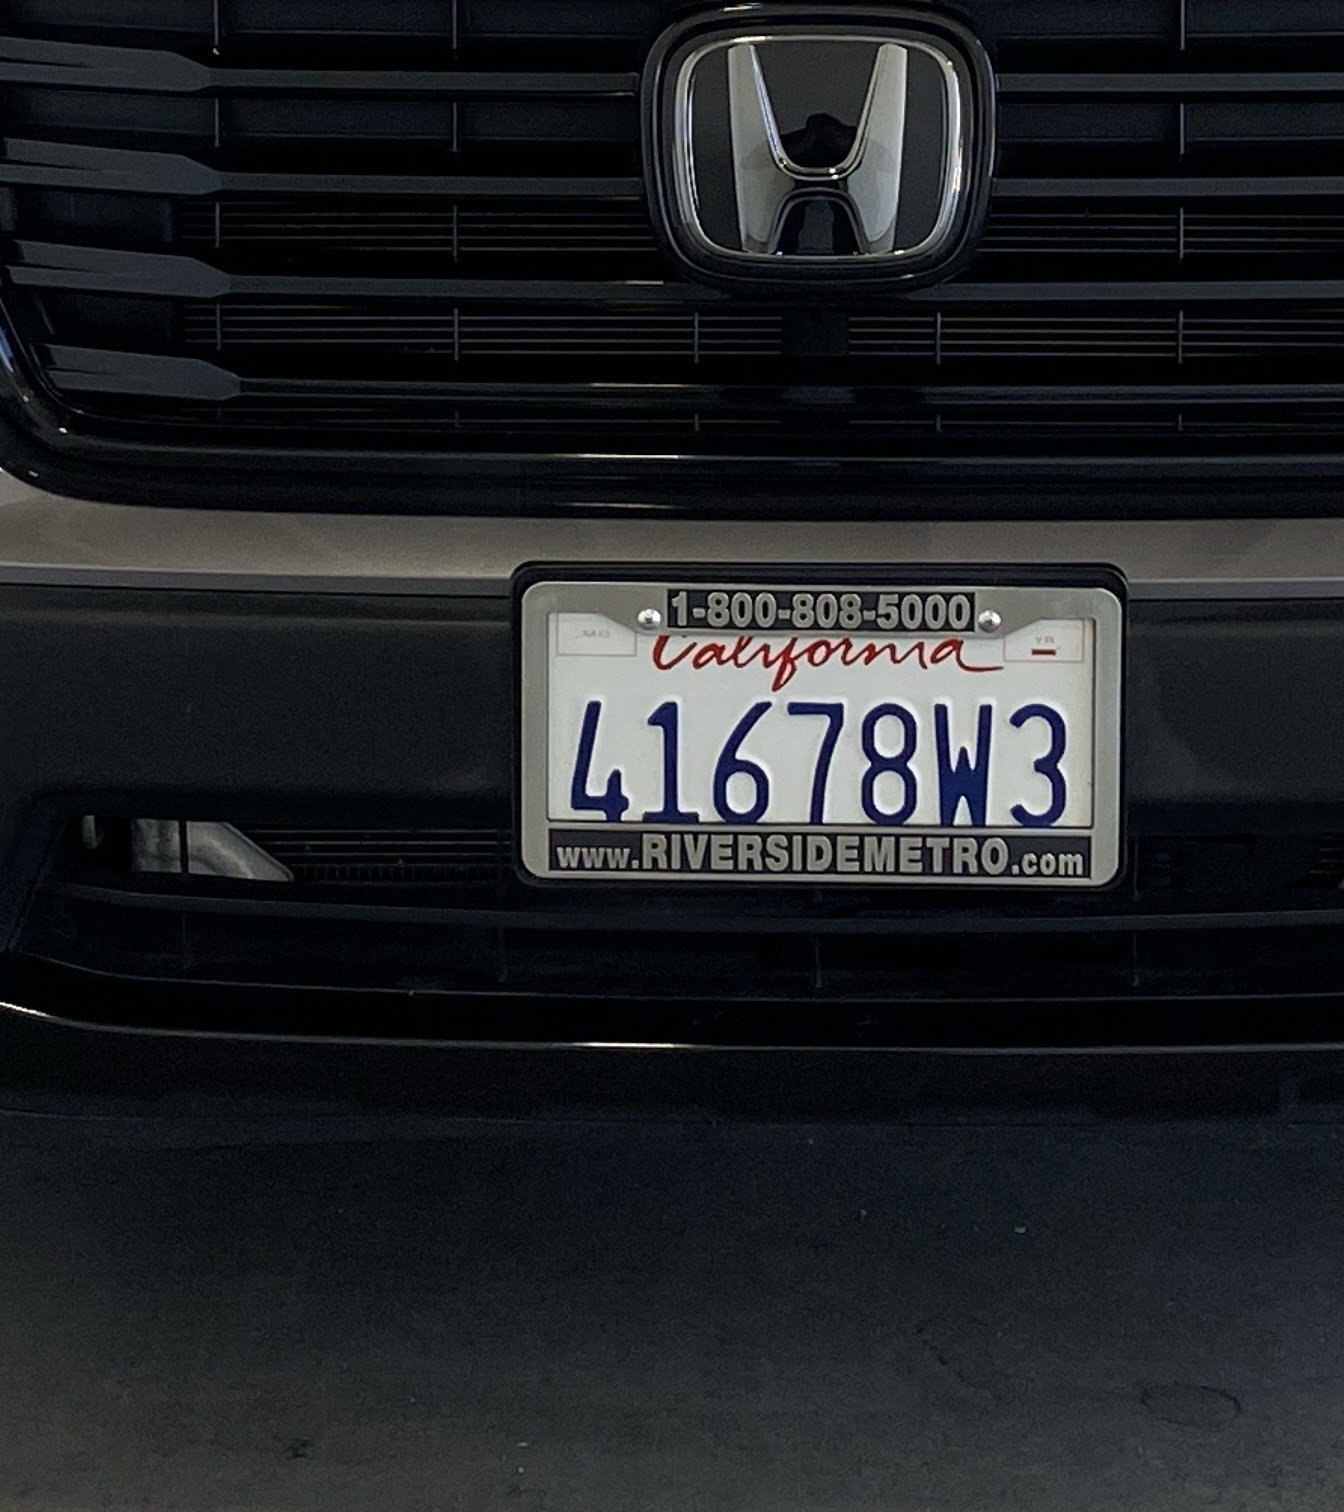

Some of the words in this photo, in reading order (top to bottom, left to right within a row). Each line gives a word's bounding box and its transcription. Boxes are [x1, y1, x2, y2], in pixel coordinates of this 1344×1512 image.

[671, 590, 971, 630] 1-800-808-5000
[652, 635, 1005, 692] California
[570, 699, 1068, 828] 41678W3
[556, 833, 1085, 876] www.RIVERSIDEMETRO.com
